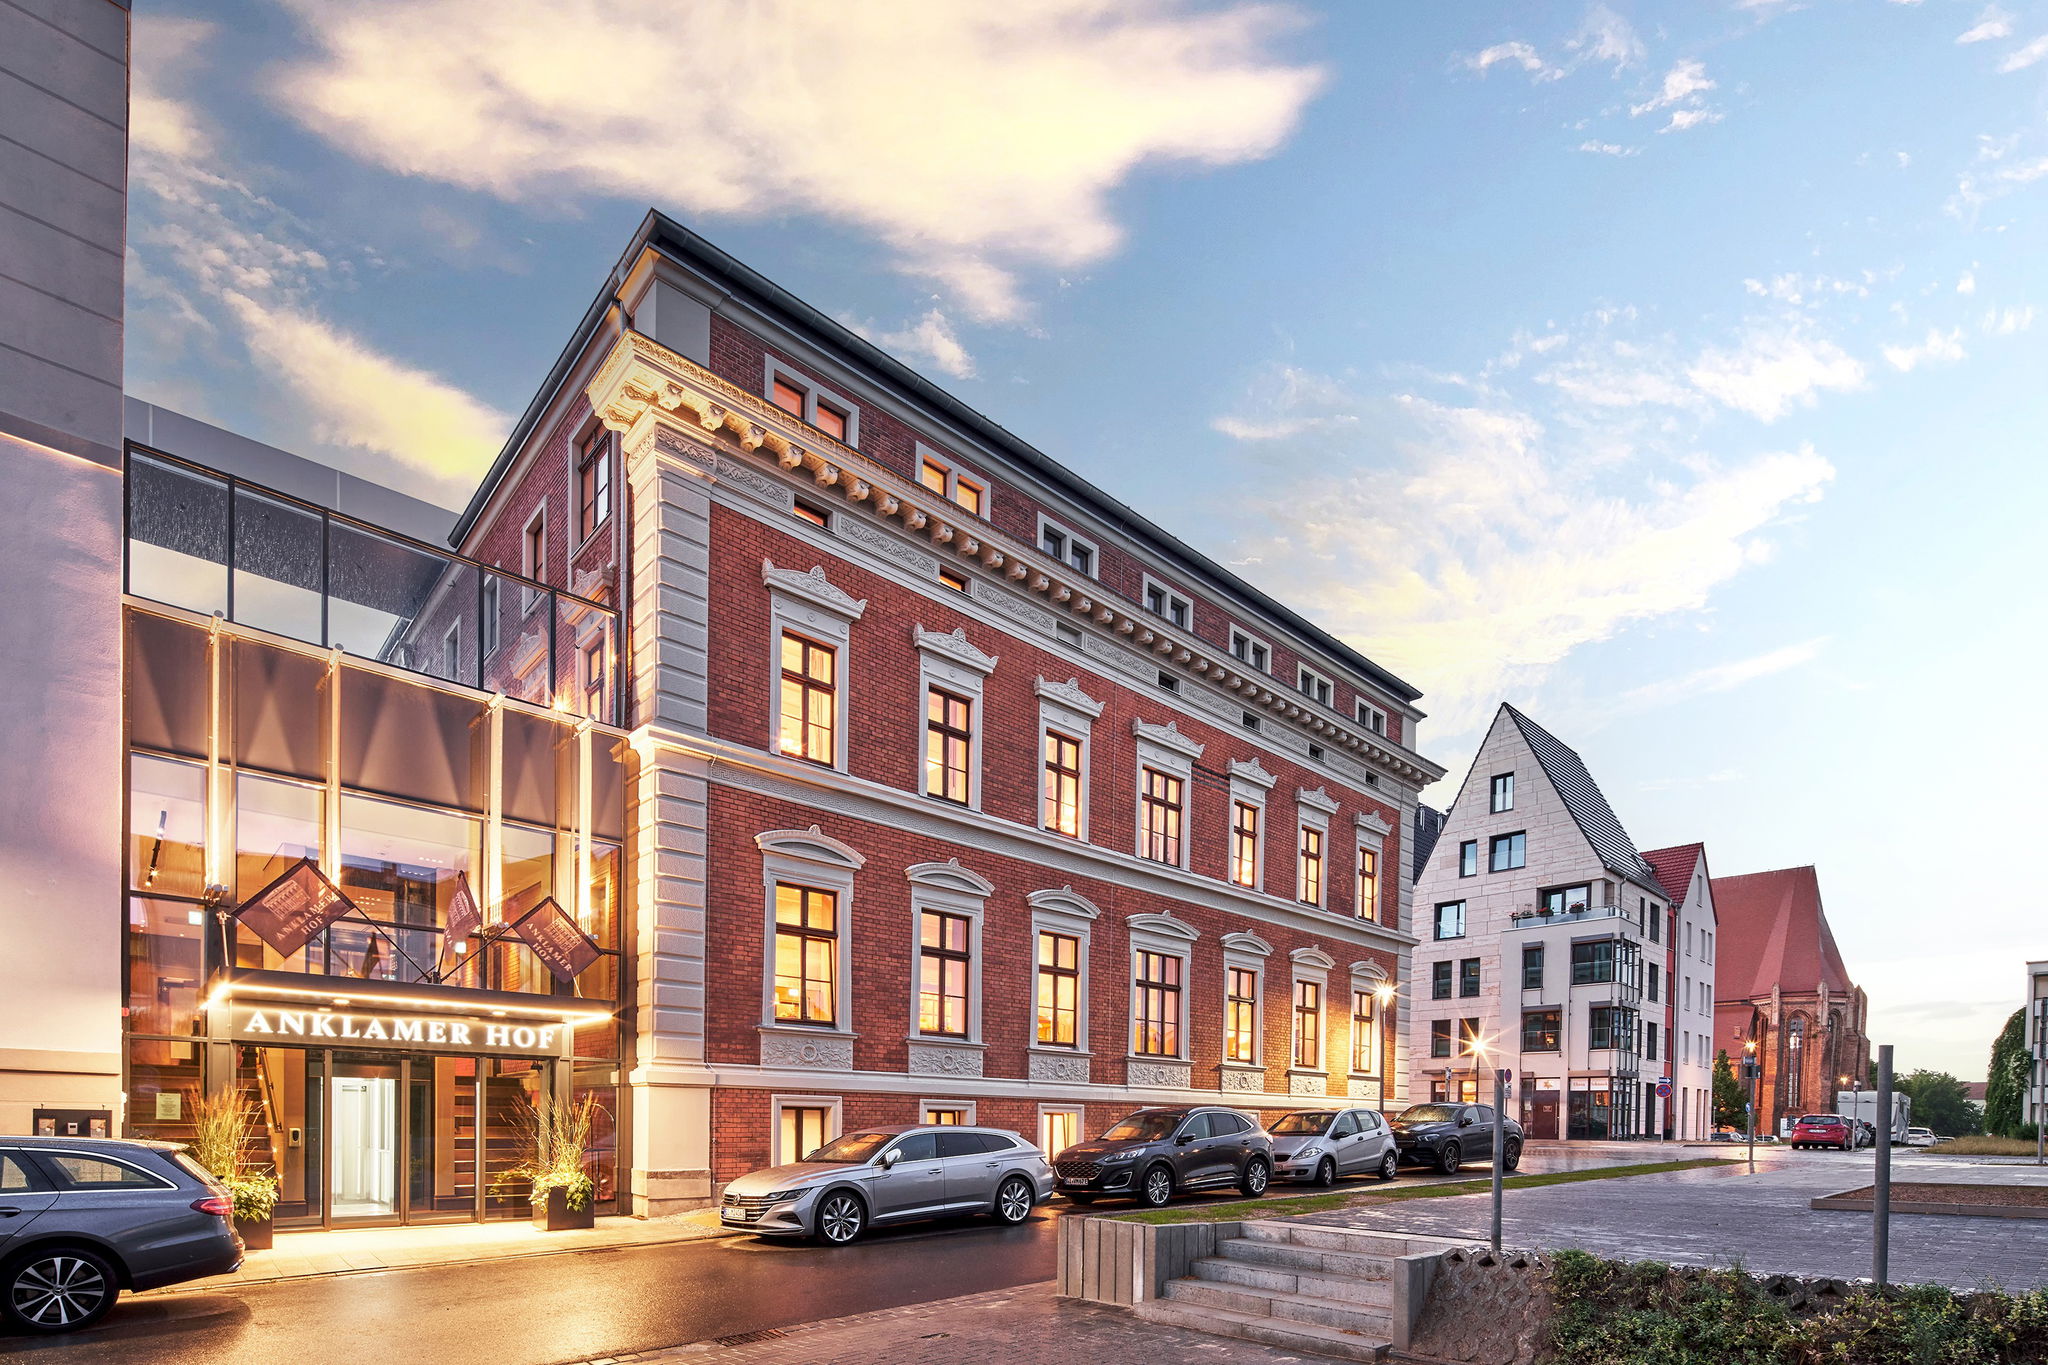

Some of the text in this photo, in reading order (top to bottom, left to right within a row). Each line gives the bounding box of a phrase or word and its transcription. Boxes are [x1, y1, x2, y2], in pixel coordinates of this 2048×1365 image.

[276, 893, 334, 940] ANKLAMER
[301, 916, 323, 935] HOF
[527, 923, 572, 972] ANKLAMER
[532, 943, 553, 962] HOF
[243, 1009, 555, 1049] ANKLAMER HOF
